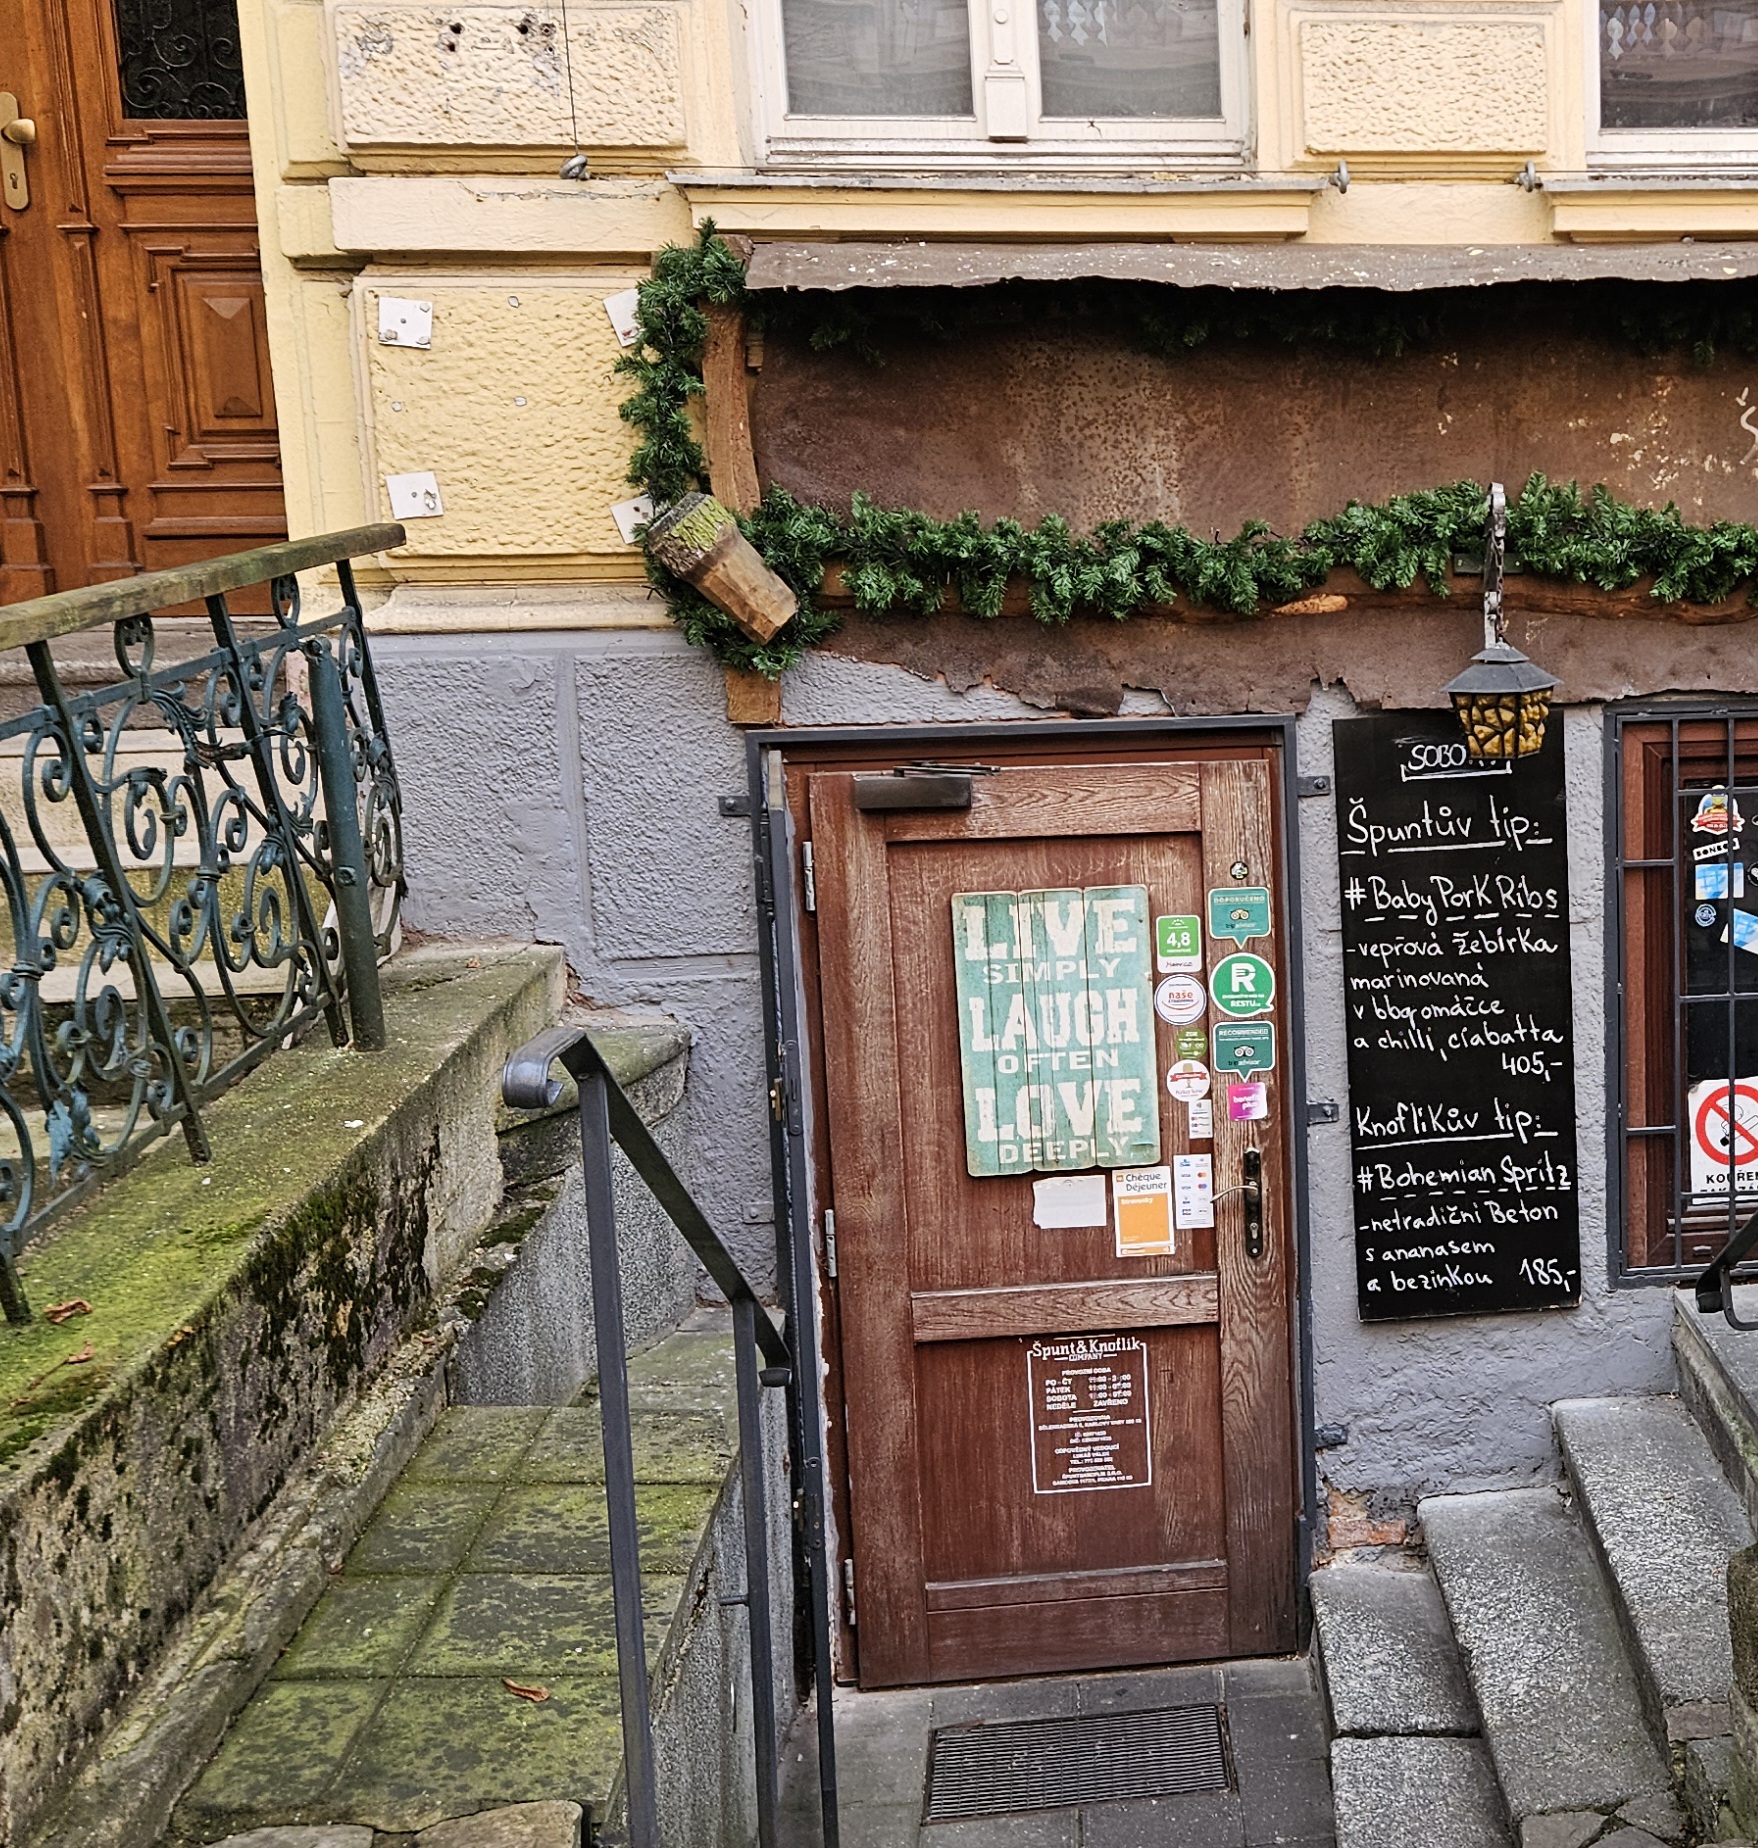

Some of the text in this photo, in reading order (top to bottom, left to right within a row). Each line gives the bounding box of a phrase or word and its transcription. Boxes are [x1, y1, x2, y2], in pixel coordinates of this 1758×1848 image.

[1408, 743, 1496, 770] SOBO
[1347, 795, 1540, 857] Špuntův tip:
[964, 899, 1137, 960] LIVE
[1167, 931, 1191, 949] 4,8
[983, 958, 1120, 984] SIMPLY
[1350, 962, 1490, 990] marinovaná
[1168, 989, 1193, 999] naše
[969, 988, 1139, 1052] LAUGH
[1353, 1004, 1364, 1020] v
[1354, 1037, 1370, 1049] a
[998, 1049, 1119, 1074] OFTEN
[1502, 1051, 1563, 1082] 405,-
[976, 1079, 1143, 1142] LOVE
[1494, 1097, 1541, 1144] tip:
[1000, 1137, 1130, 1164] DEEPLY
[1484, 1199, 1559, 1224] Beton
[1366, 1240, 1496, 1262] s ananasem
[1367, 1279, 1382, 1292] a
[1519, 1258, 1577, 1293] 185,-
[1068, 1352, 1103, 1361] COMPANY
